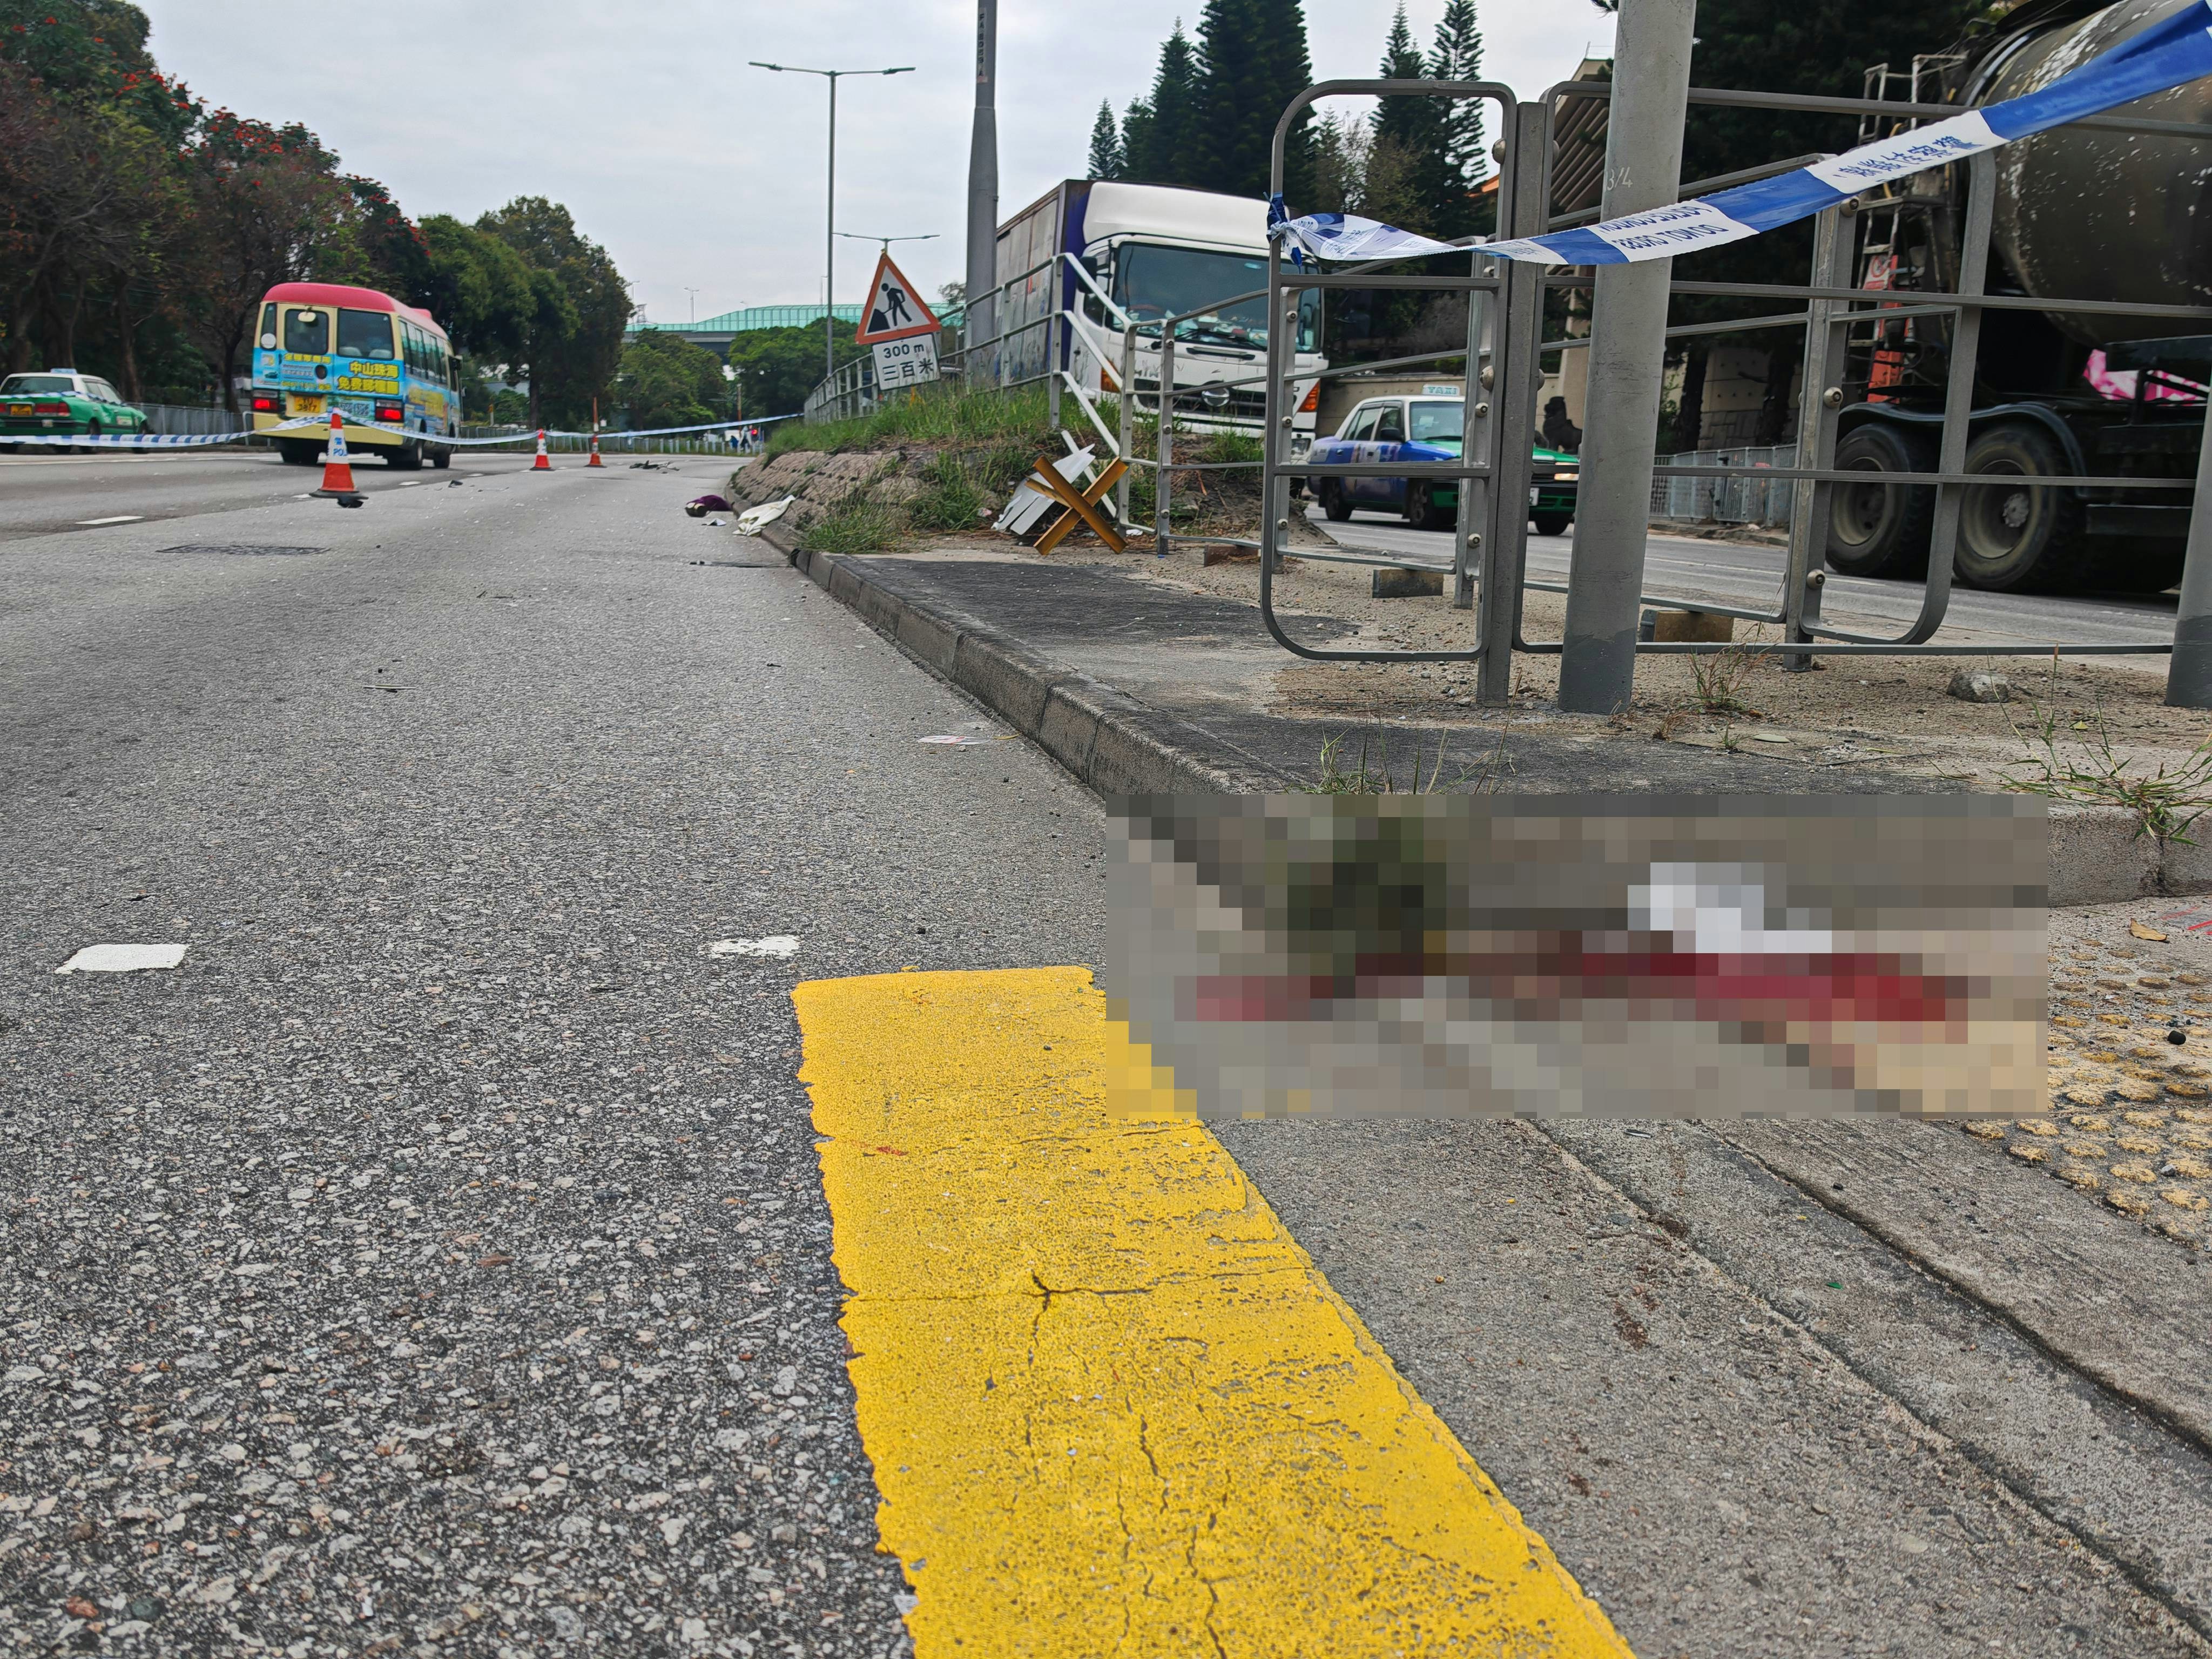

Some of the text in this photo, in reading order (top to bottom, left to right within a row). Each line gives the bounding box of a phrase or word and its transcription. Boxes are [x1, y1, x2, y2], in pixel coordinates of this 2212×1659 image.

[883, 344, 924, 359] 300 m
[882, 358, 934, 381] 三百米
[1428, 387, 1456, 395] TAXI
